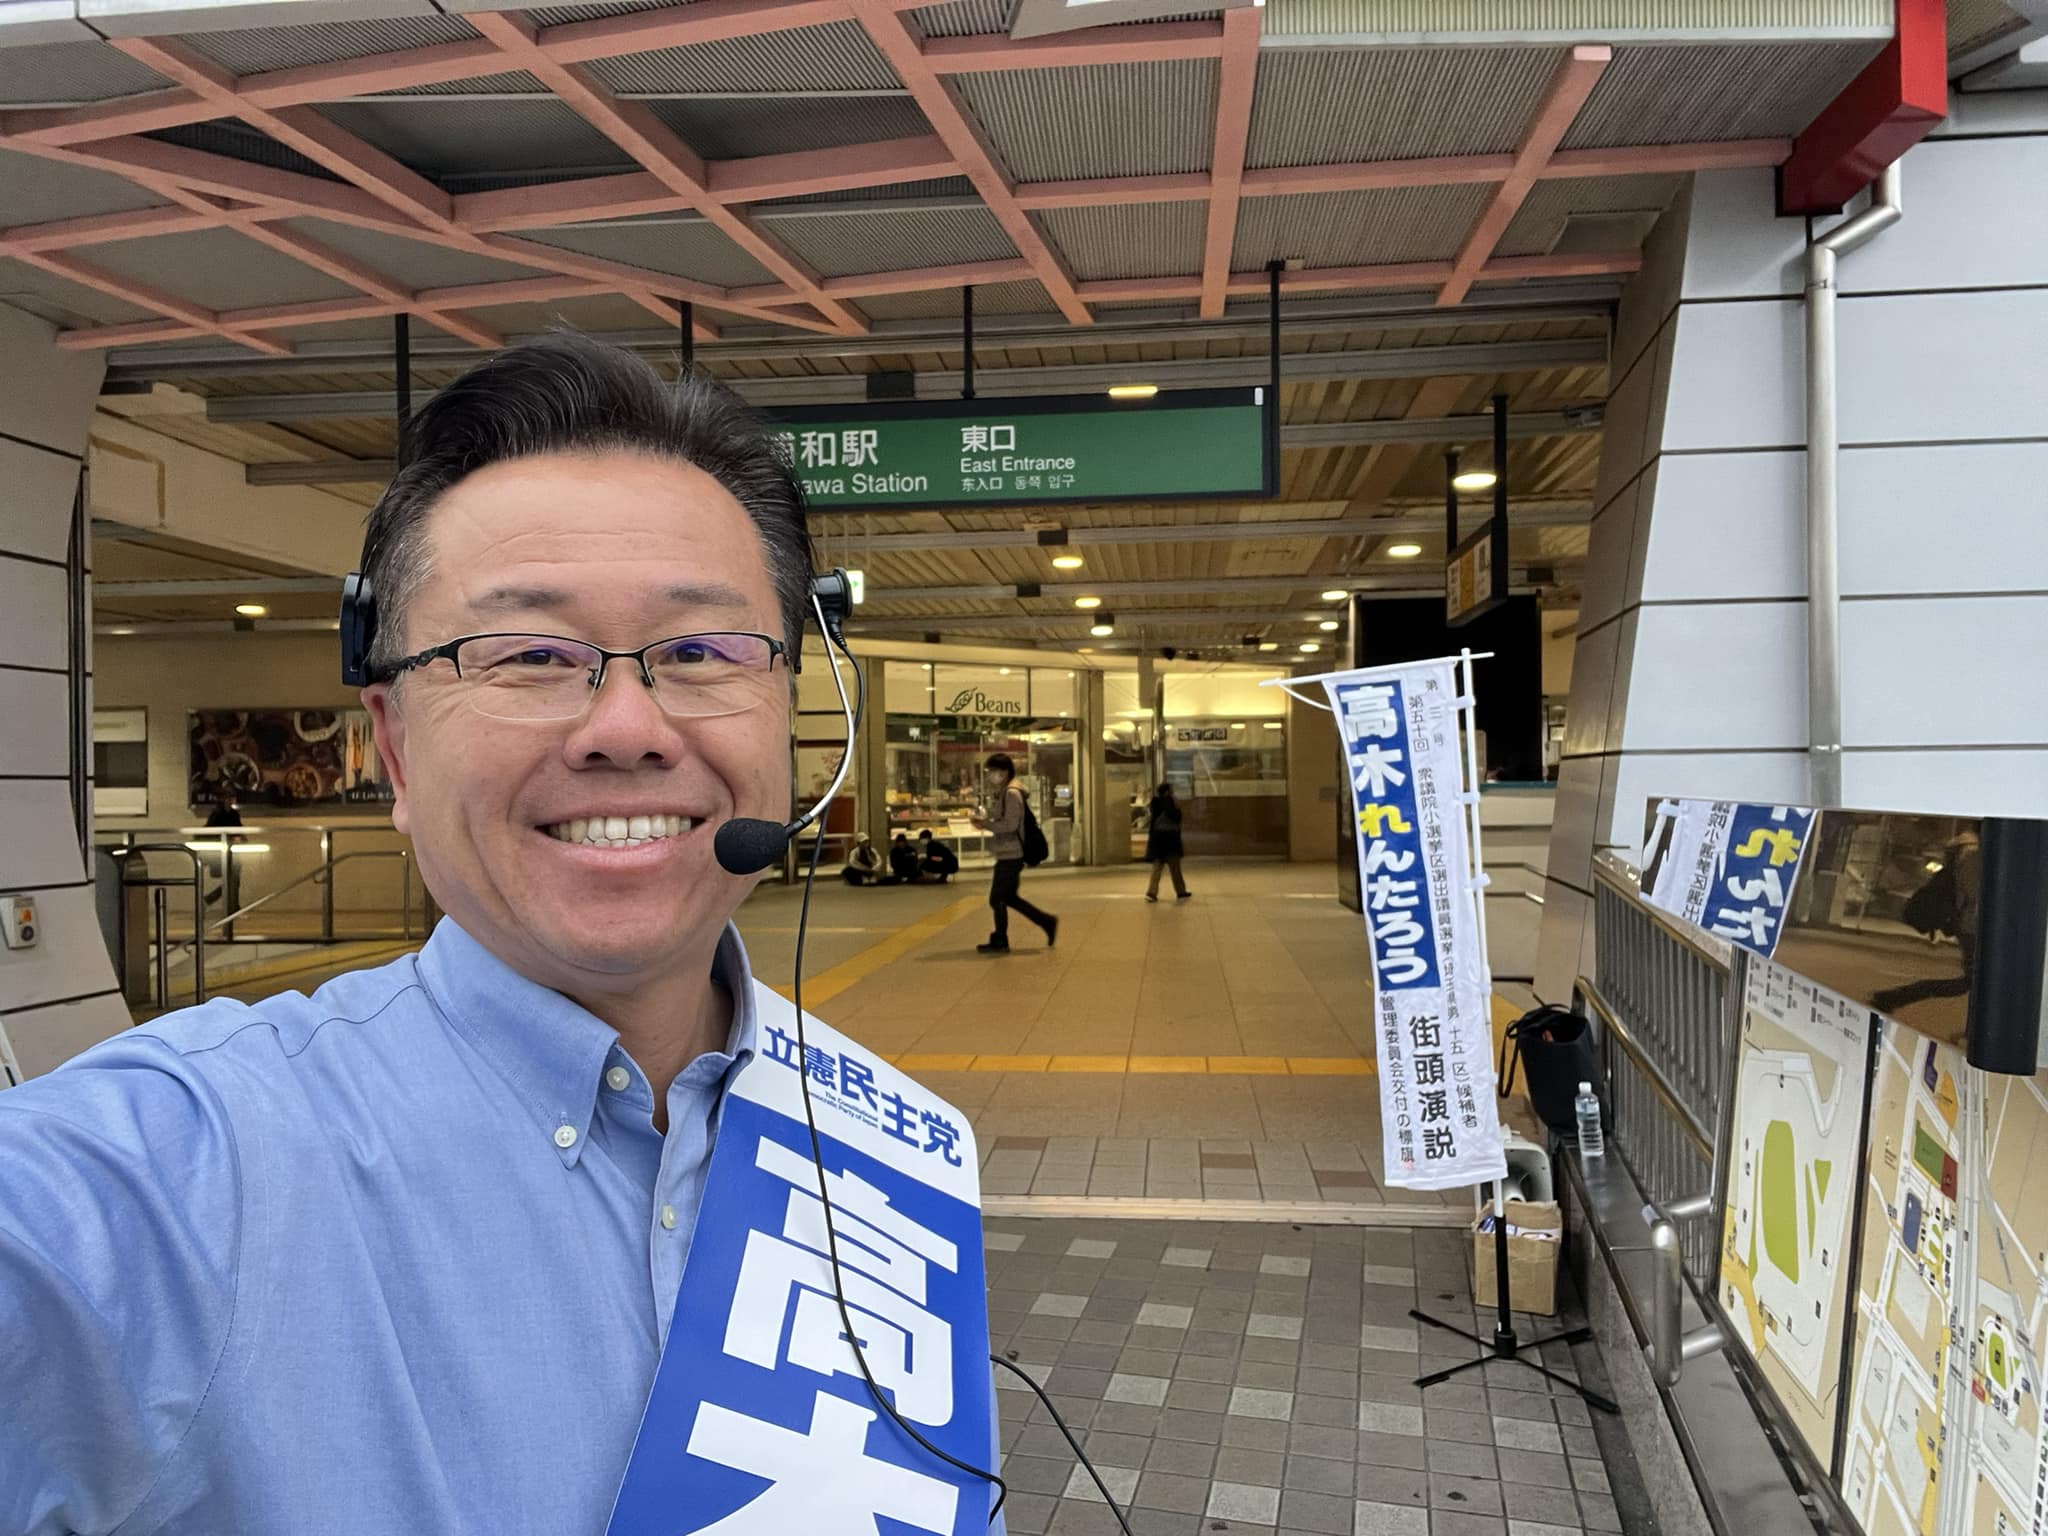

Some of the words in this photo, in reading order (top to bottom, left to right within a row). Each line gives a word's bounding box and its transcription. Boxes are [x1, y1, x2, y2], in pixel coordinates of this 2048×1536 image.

[960, 425, 1016, 452] 東口
[960, 458, 997, 473] East
[1001, 456, 1075, 472] Entrance
[801, 478, 845, 496] awa
[851, 472, 928, 494] Station
[961, 477, 1003, 492] 东入口
[1014, 475, 1041, 490] 동쪽
[1048, 473, 1076, 489] 입구
[975, 692, 1021, 713] Beans
[1339, 685, 1428, 984] 高木れんたろう
[1380, 990, 1416, 1163] 管理委員会交付の標旗
[1409, 1015, 1457, 1160] 街頭演説
[762, 1024, 962, 1167] 立憲民主党
